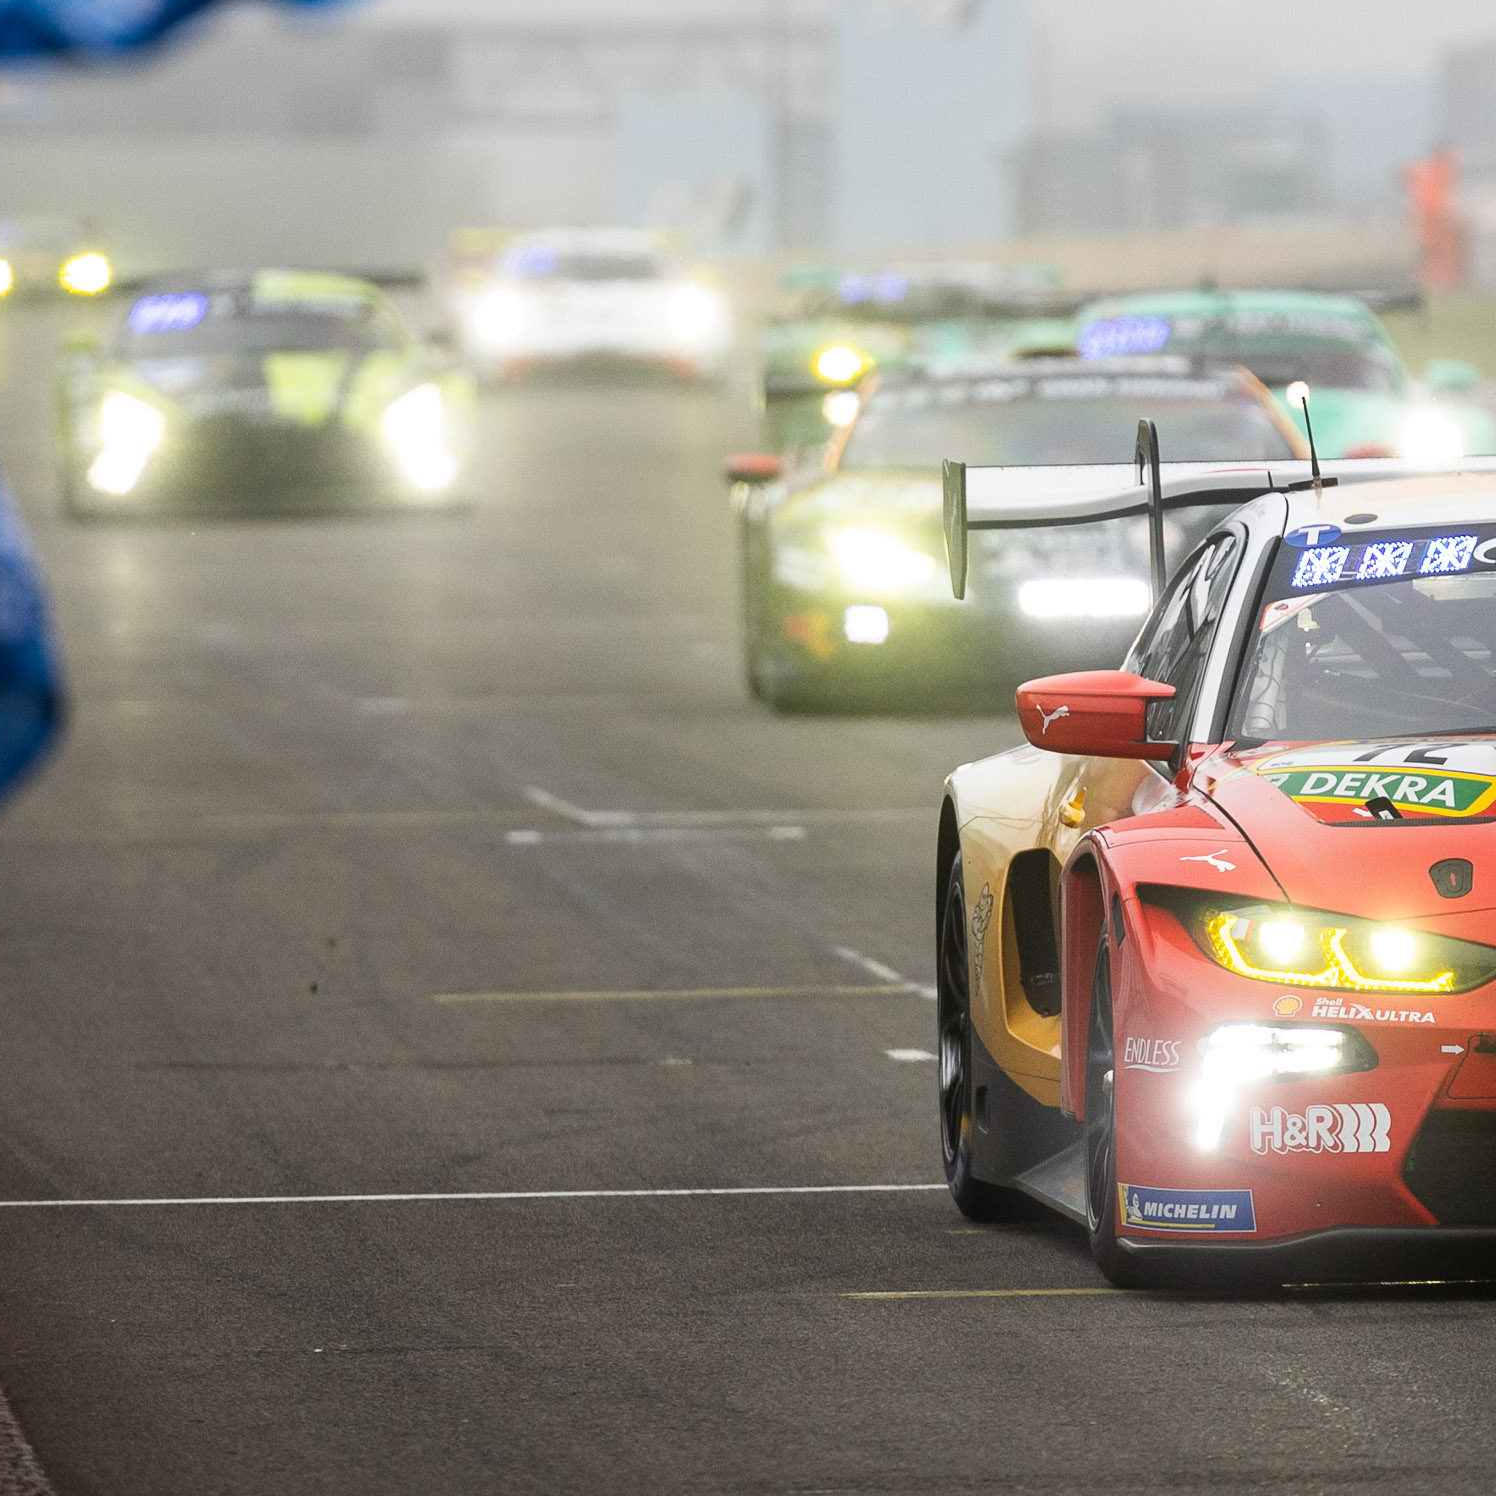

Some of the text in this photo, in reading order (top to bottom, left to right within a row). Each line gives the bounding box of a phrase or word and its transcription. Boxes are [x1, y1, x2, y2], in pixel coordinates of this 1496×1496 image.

[1300, 772, 1456, 809] DEKRA
[1311, 1003, 1436, 1024] HELIX ULTRA
[1315, 997, 1343, 1007] Shell
[1123, 1036, 1182, 1066] ENDLESS
[1249, 1104, 1344, 1155] H&R
[1143, 1201, 1238, 1220] MICHELIN
